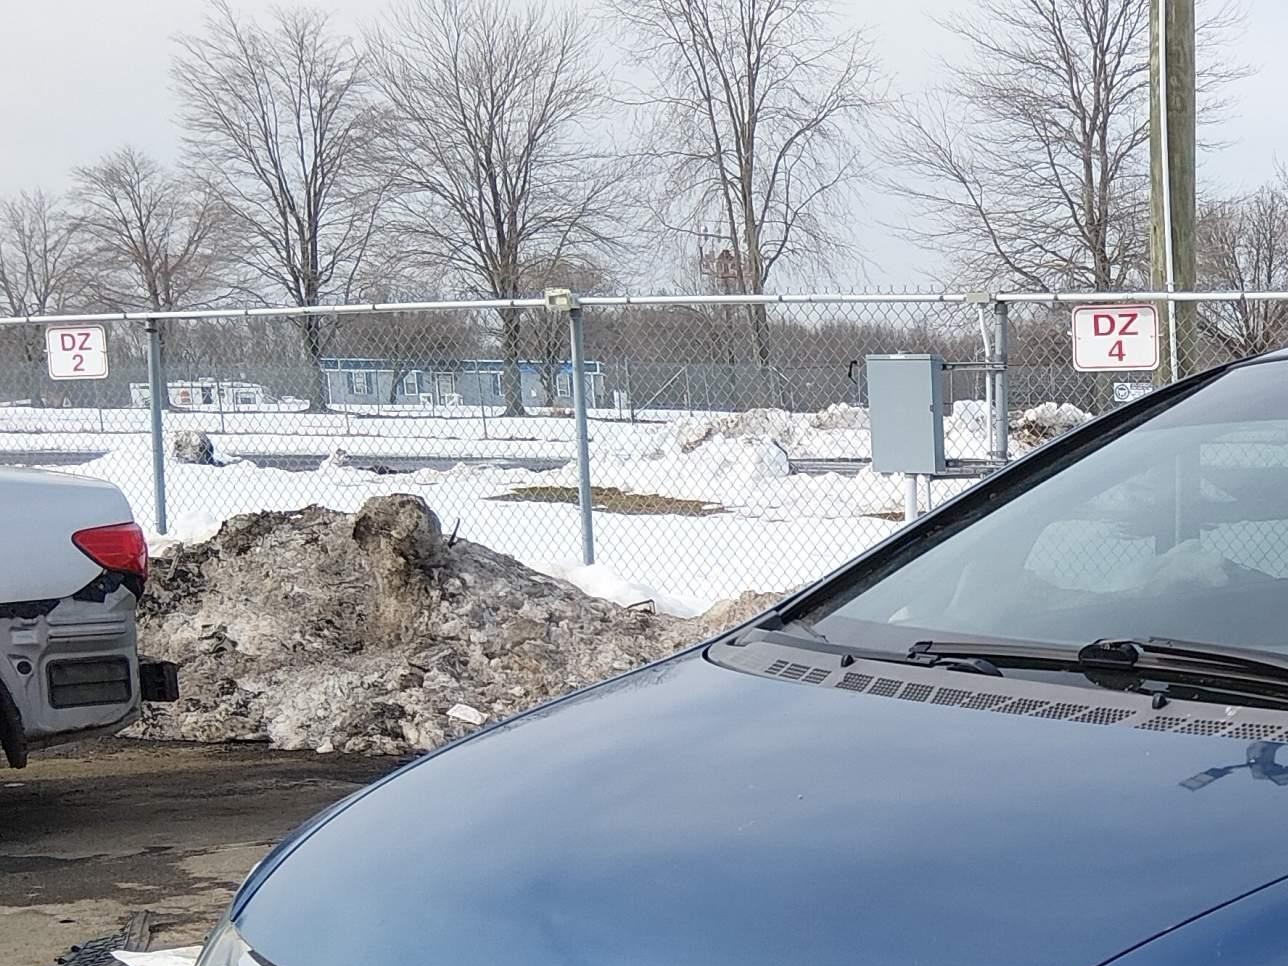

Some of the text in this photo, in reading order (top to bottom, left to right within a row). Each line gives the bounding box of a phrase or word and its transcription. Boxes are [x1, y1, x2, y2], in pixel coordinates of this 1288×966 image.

[1093, 313, 1138, 336] DZ
[60, 332, 92, 351] DZ
[1108, 340, 1126, 361] 4
[72, 353, 85, 371] 2
